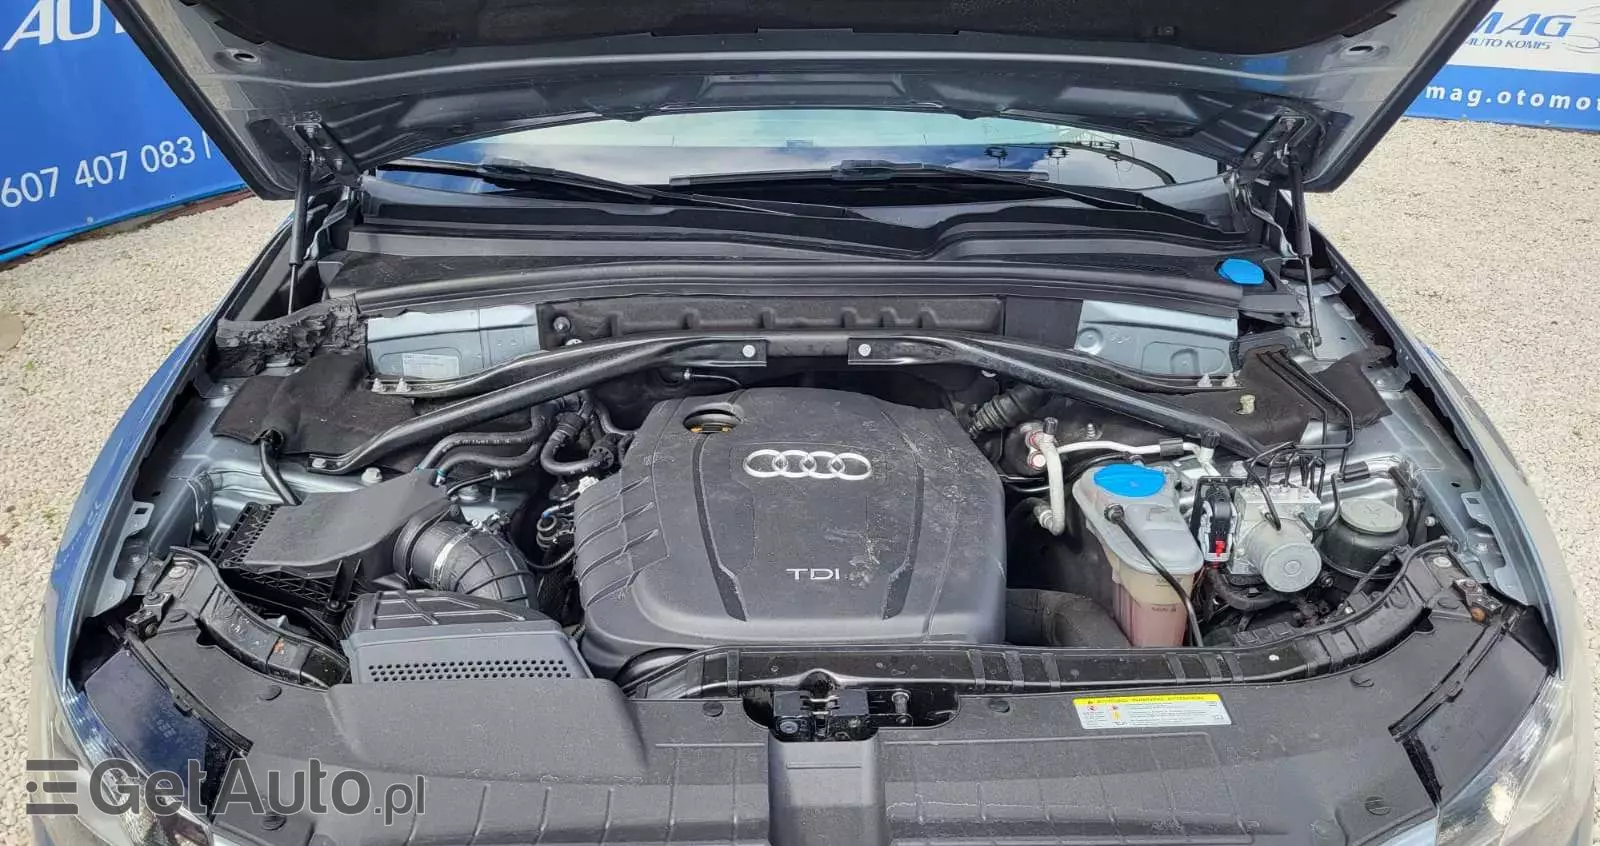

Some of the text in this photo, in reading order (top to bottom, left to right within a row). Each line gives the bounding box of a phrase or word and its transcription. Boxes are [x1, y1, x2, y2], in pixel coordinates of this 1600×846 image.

[2, 0, 126, 51] AU
[1467, 37, 1552, 50] AUTO KOMIS
[1, 166, 59, 208] 607
[74, 150, 128, 188] 407
[140, 136, 196, 173] 083
[785, 567, 840, 581] TDI
